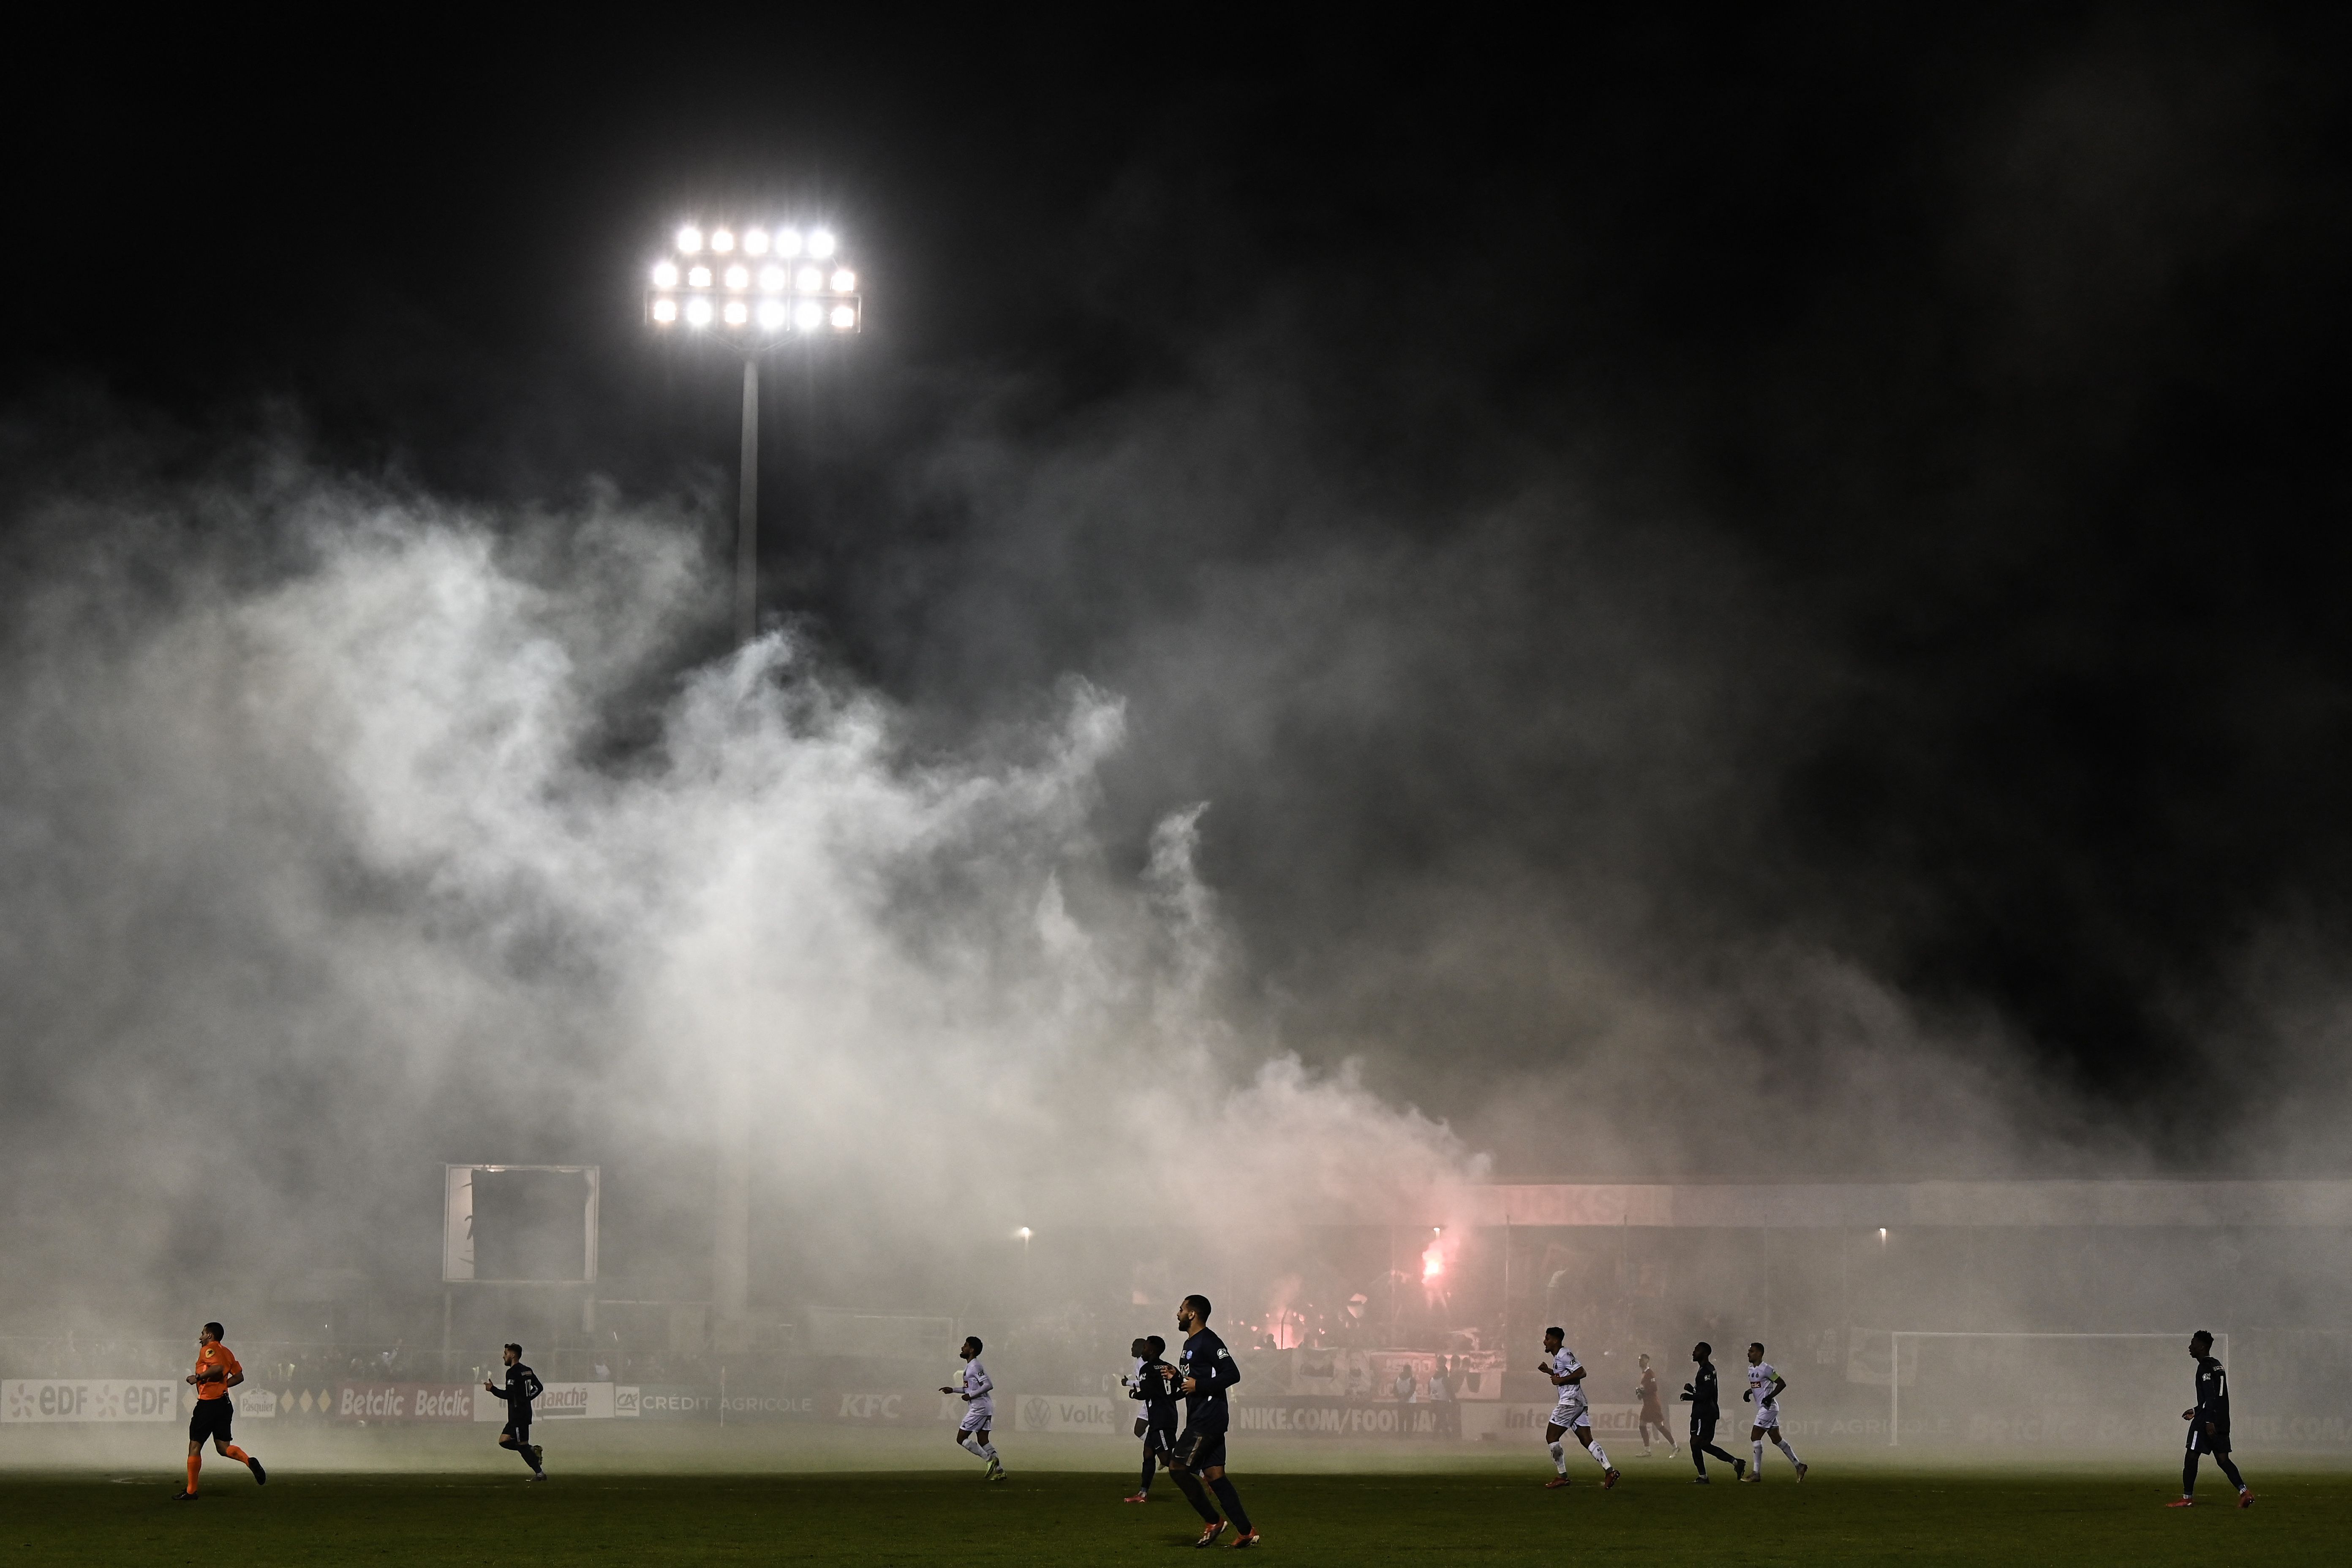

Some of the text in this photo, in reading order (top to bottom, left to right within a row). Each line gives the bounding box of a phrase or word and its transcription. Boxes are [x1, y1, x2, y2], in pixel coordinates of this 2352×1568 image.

[242, 1398, 273, 1414] Pasquier
[340, 1388, 404, 1416] Betclic
[415, 1389, 470, 1416] Betclic
[642, 1394, 712, 1410] CRÉDIT
[719, 1396, 812, 1411] AGRICOLE
[838, 1394, 901, 1418] KFC
[1060, 1403, 1115, 1424] Volks
